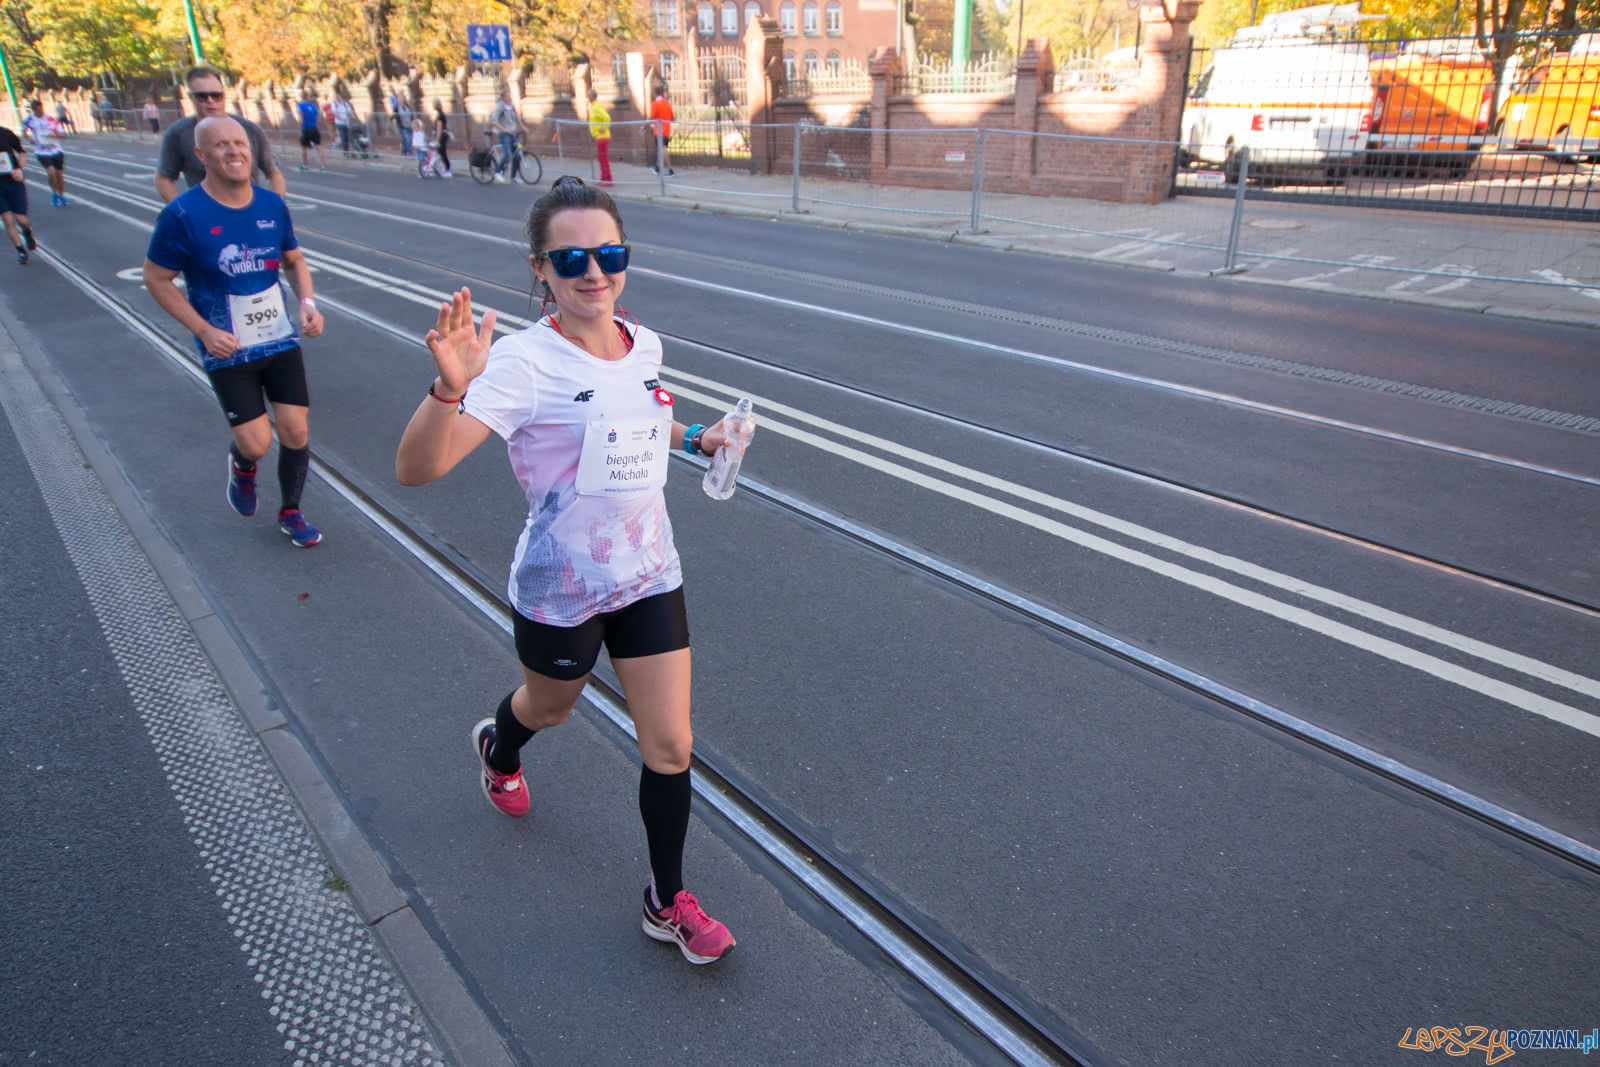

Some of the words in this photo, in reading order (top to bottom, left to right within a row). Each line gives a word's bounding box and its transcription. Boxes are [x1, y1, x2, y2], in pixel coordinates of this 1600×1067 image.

[230, 258, 265, 274] WORLD
[243, 305, 278, 326] 3996
[606, 454, 640, 468] biegnę
[641, 450, 653, 463] dla
[609, 468, 648, 480] Michała
